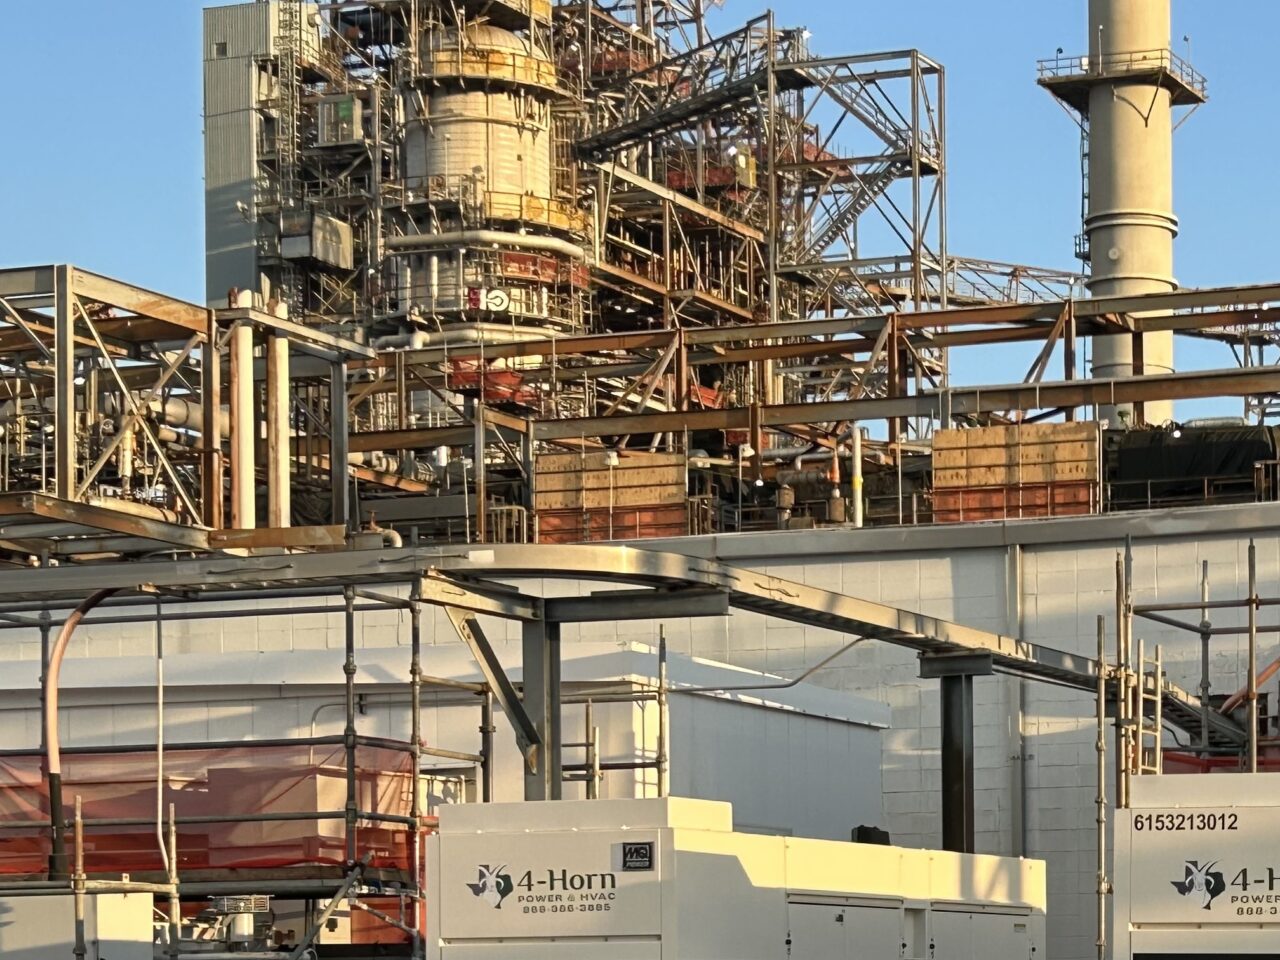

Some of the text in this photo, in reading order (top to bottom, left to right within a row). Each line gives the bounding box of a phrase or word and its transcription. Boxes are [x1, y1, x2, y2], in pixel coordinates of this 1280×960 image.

[1133, 813, 1238, 831] 6153213012
[625, 846, 649, 860] MQ
[517, 869, 616, 892] 4-Horn
[518, 894, 563, 903] POWER
[580, 892, 616, 901] HVAC
